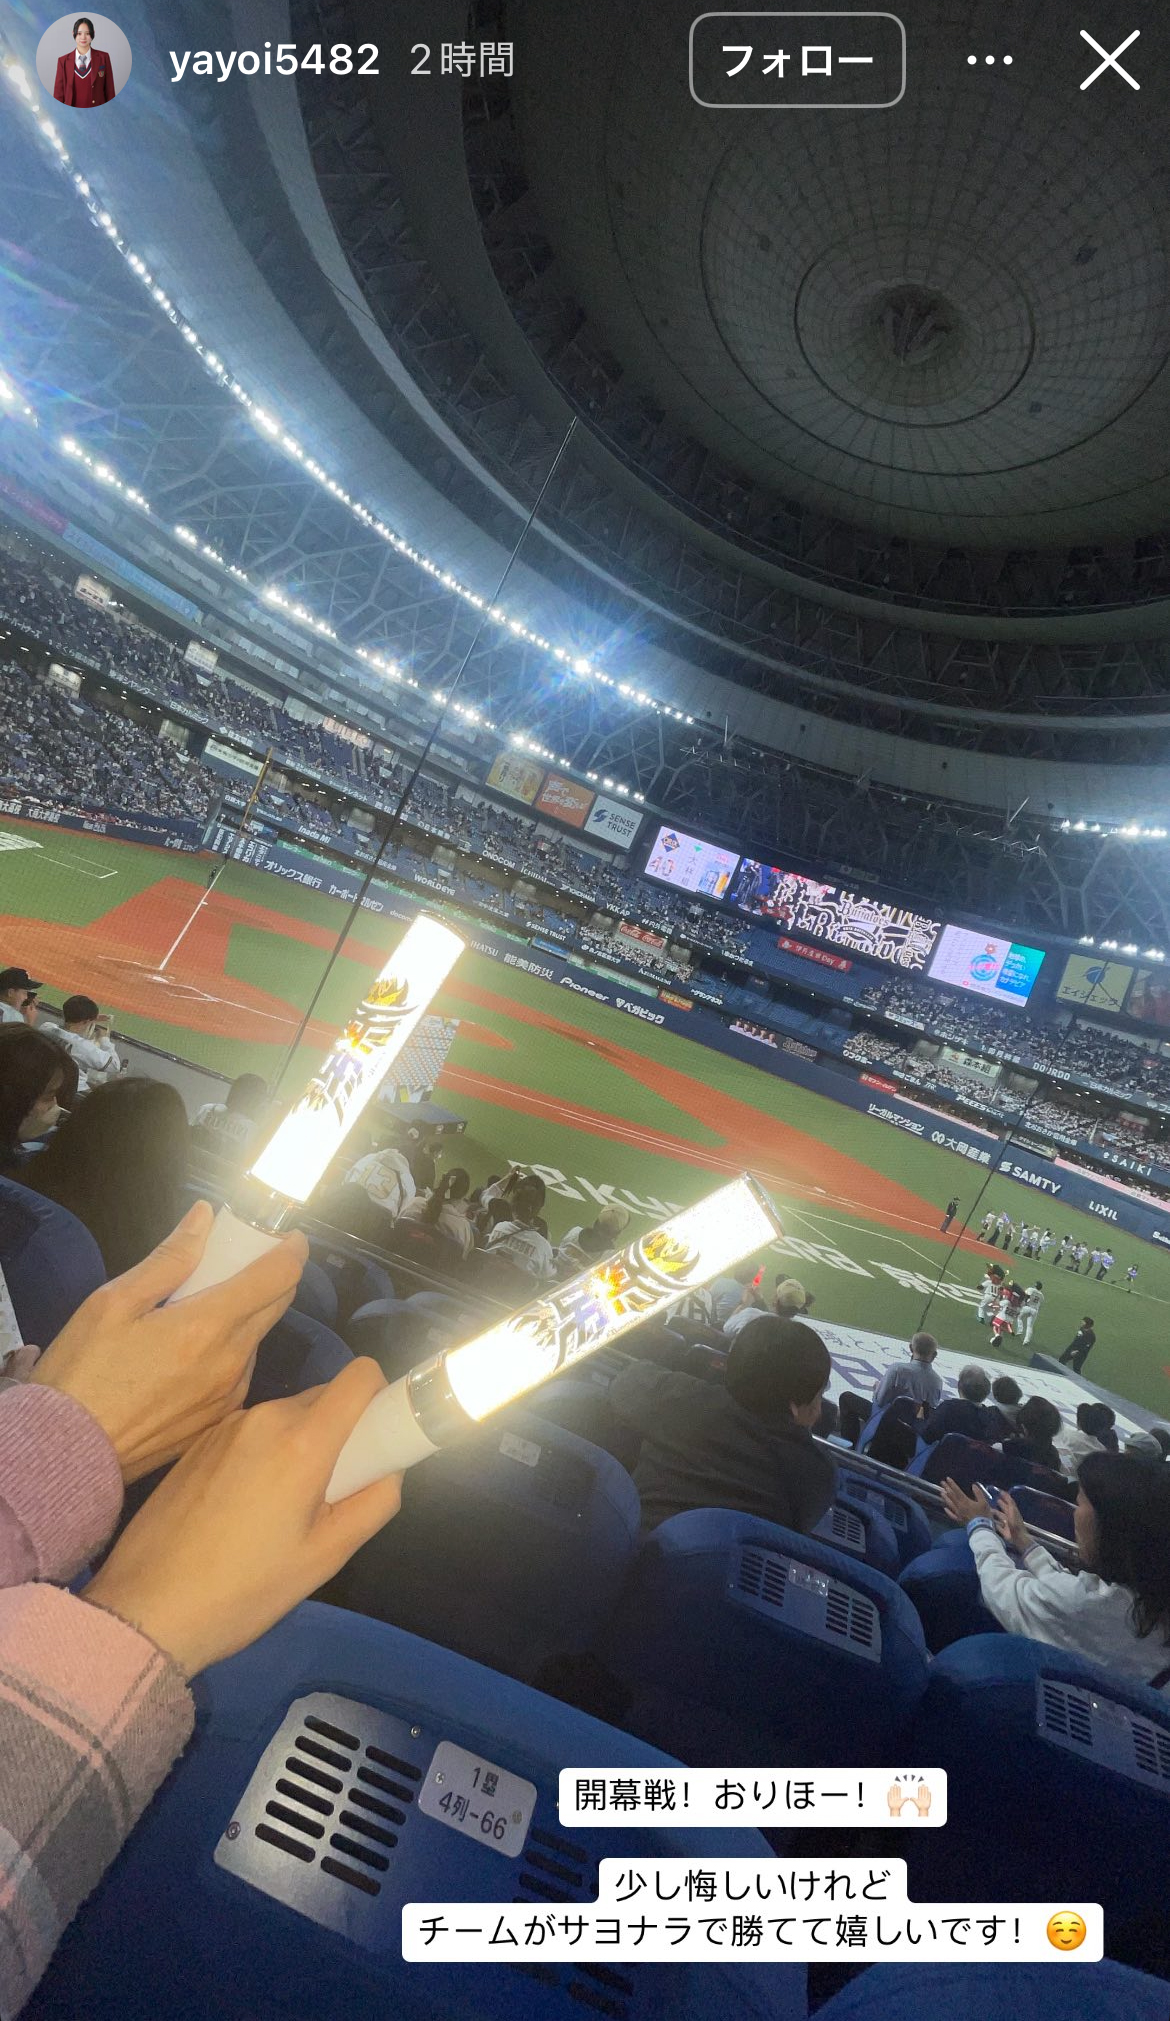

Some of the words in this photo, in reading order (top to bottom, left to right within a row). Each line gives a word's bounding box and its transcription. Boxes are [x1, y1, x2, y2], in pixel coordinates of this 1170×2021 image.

[607, 821, 632, 838] TRUST
[609, 813, 636, 830] SENSE
[482, 850, 516, 868] ONOCOM
[264, 860, 323, 889] オリックス銀行
[606, 903, 620, 914] YKK
[619, 907, 631, 917] AP
[531, 923, 549, 935] SENSE
[549, 930, 567, 942] TRUST
[504, 952, 554, 980] 能美防災
[560, 977, 609, 1002] Pioneer
[869, 1103, 925, 1132] リーガルマンション
[944, 1137, 992, 1165] 大岡産業
[1012, 1166, 1062, 1194] SAMTY
[1088, 1200, 1119, 1221] LIXIL
[472, 1765, 500, 1799] 1塁
[437, 1790, 507, 1841] 4列-66
